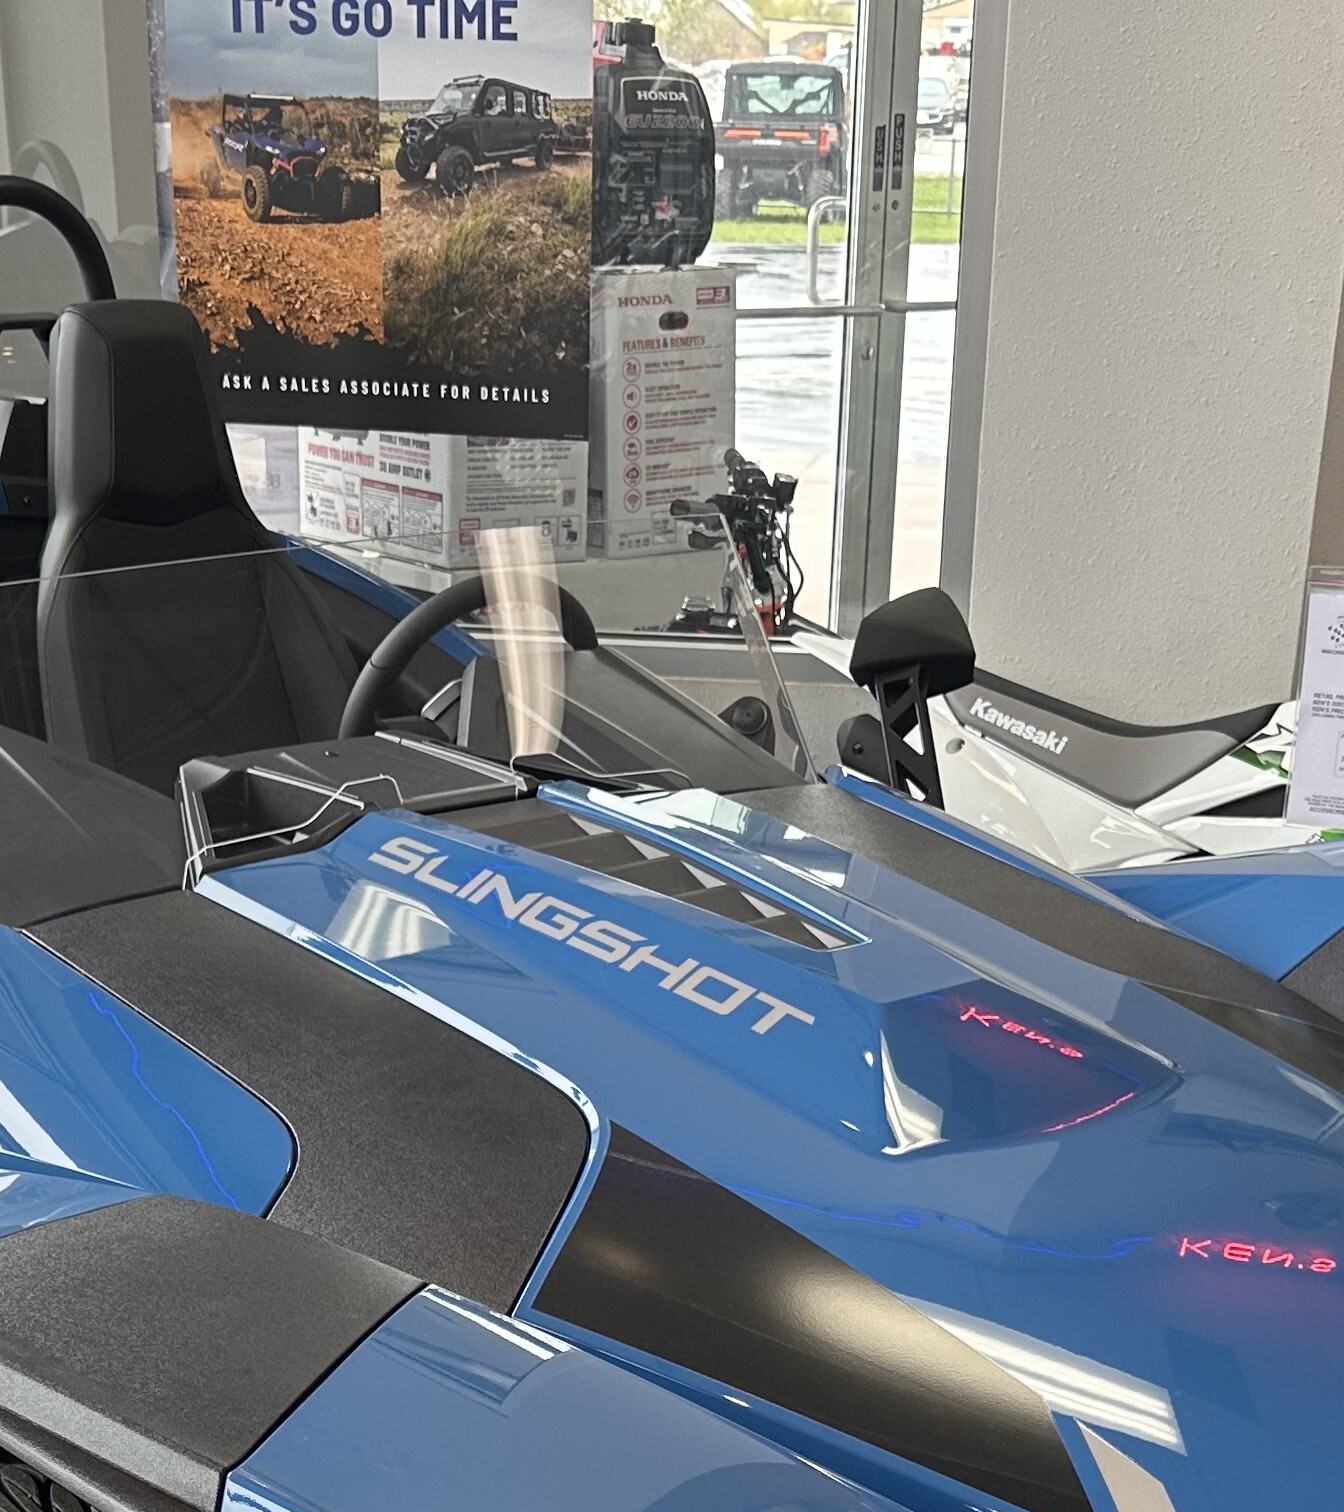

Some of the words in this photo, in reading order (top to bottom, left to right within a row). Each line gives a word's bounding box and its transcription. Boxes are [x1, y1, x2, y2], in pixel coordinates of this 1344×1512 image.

[233, 0, 317, 35] IT'S
[332, 0, 392, 37] GO
[406, 0, 518, 41] TIME
[636, 91, 689, 102] HONDA
[895, 116, 903, 163] PUSH
[617, 294, 673, 308] HONDA
[623, 339, 661, 353] FEATURES
[670, 336, 705, 348] BENEFITS
[222, 374, 253, 390] ASK
[261, 376, 270, 391] A
[279, 377, 330, 393] SALES
[340, 380, 430, 398] ASSOCIATE
[440, 385, 470, 400] FOR
[480, 386, 550, 404] DETAILS
[308, 443, 329, 457] POWER
[329, 447, 341, 461] YOU
[341, 450, 354, 464] CAN
[356, 452, 375, 468] TRUST
[403, 466, 423, 480] OUTLET
[969, 697, 1068, 755] Kawasaki
[368, 836, 815, 1035] SLINGSHOT
